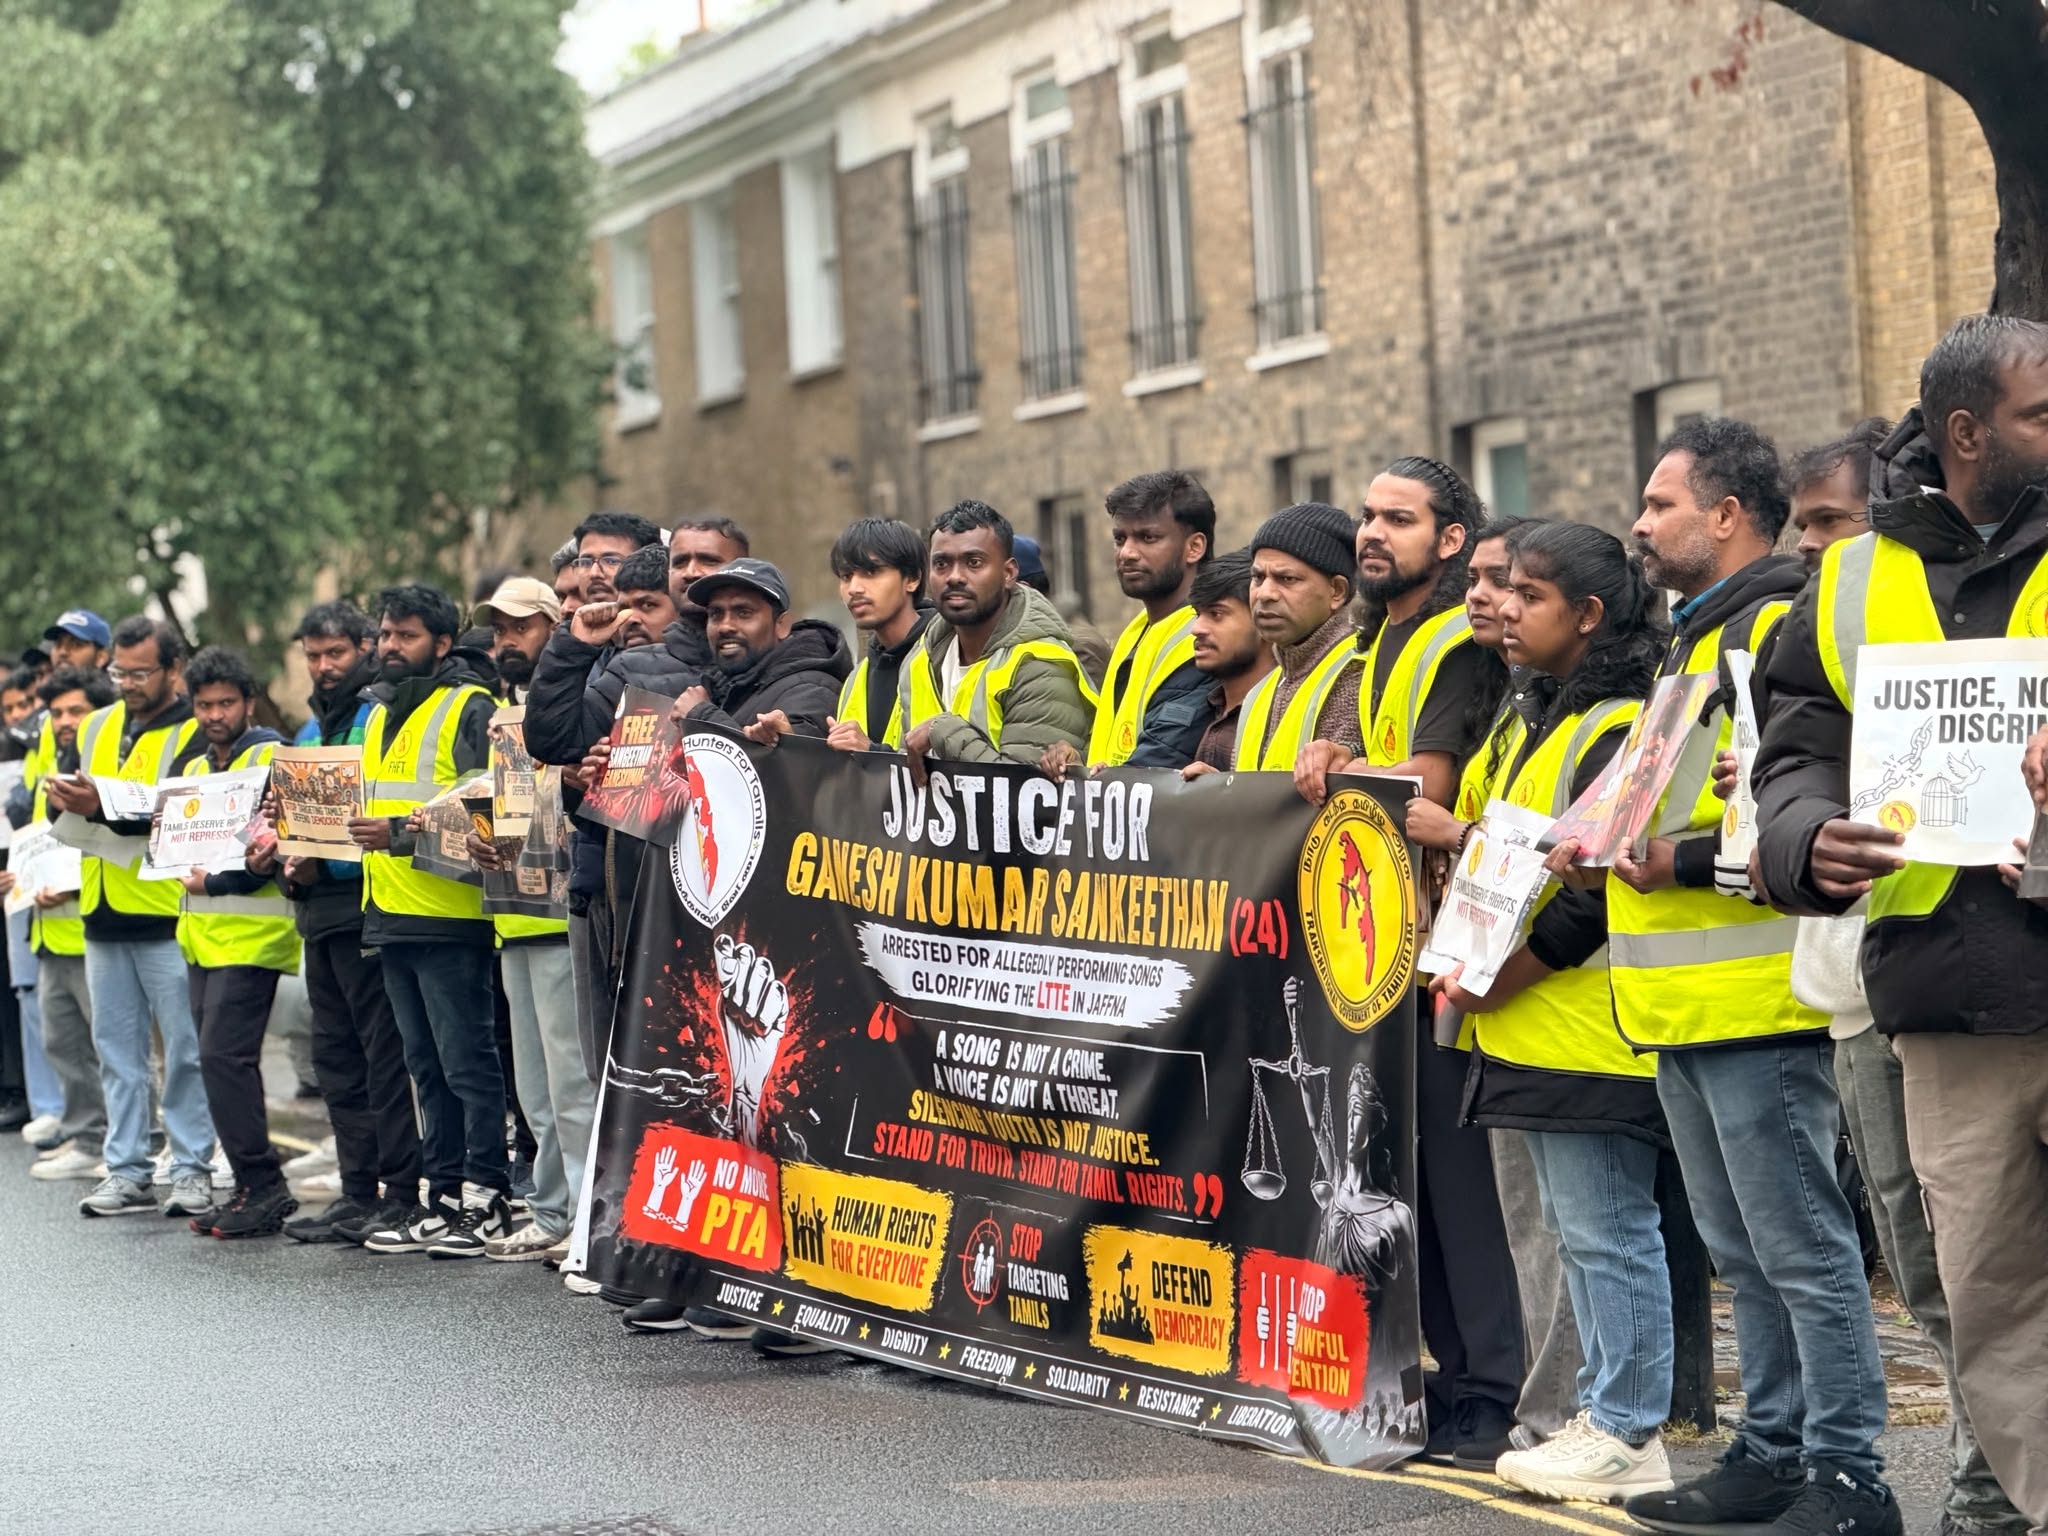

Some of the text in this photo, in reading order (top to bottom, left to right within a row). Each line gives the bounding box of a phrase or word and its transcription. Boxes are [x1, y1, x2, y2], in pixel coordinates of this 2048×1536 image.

[1874, 677, 2006, 712] JUSTICE,
[620, 714, 659, 745] FREE
[683, 737, 764, 840] Hunters For Tamils
[883, 764, 1153, 861] JUSTICE FOR
[163, 821, 189, 833] TAMILS
[190, 819, 224, 830] DESERVE
[786, 832, 902, 917] GANESH
[906, 854, 1049, 935] KUMAR
[1052, 869, 1229, 952] SANKEETHAN
[1229, 897, 1288, 960] (24)
[1486, 891, 1518, 917] RIGHTS,
[882, 933, 1164, 988] ARRESTED FOR ALLEGEDLY PERFORMING SONGS
[912, 970, 1128, 1018] GLORIFYING THE LTTE IN JAFFNA
[1371, 998, 1381, 1013] OF
[936, 1030, 1112, 1082] A SONG IS NOT A CRIME.
[933, 1063, 1120, 1120] A VOICE IS NOT A THREAT.
[908, 1090, 1160, 1166] SILENCING YOUTH IS NOT JUSTICE.
[713, 1158, 770, 1201] NO MORE
[874, 1122, 1188, 1213] STAND FOR TRUTH. STAND FOR TAMIL RIGHTS.
[700, 1193, 767, 1259] PTA
[831, 1196, 937, 1250] HUMAN RIGHTS
[1010, 1223, 1043, 1262] STOP
[831, 1239, 929, 1289] FOR EVERYONE
[1007, 1262, 1069, 1301] TARGETING
[1152, 1261, 1212, 1308] DEFEND
[1007, 1295, 1050, 1330] TAMILS
[1154, 1308, 1225, 1351] DEMOCRACY
[717, 1283, 1295, 1438] JUSTICE EQUALITY DIGNITY FREEDOM SOLIDARITY RESISTANCE LIBERATION
